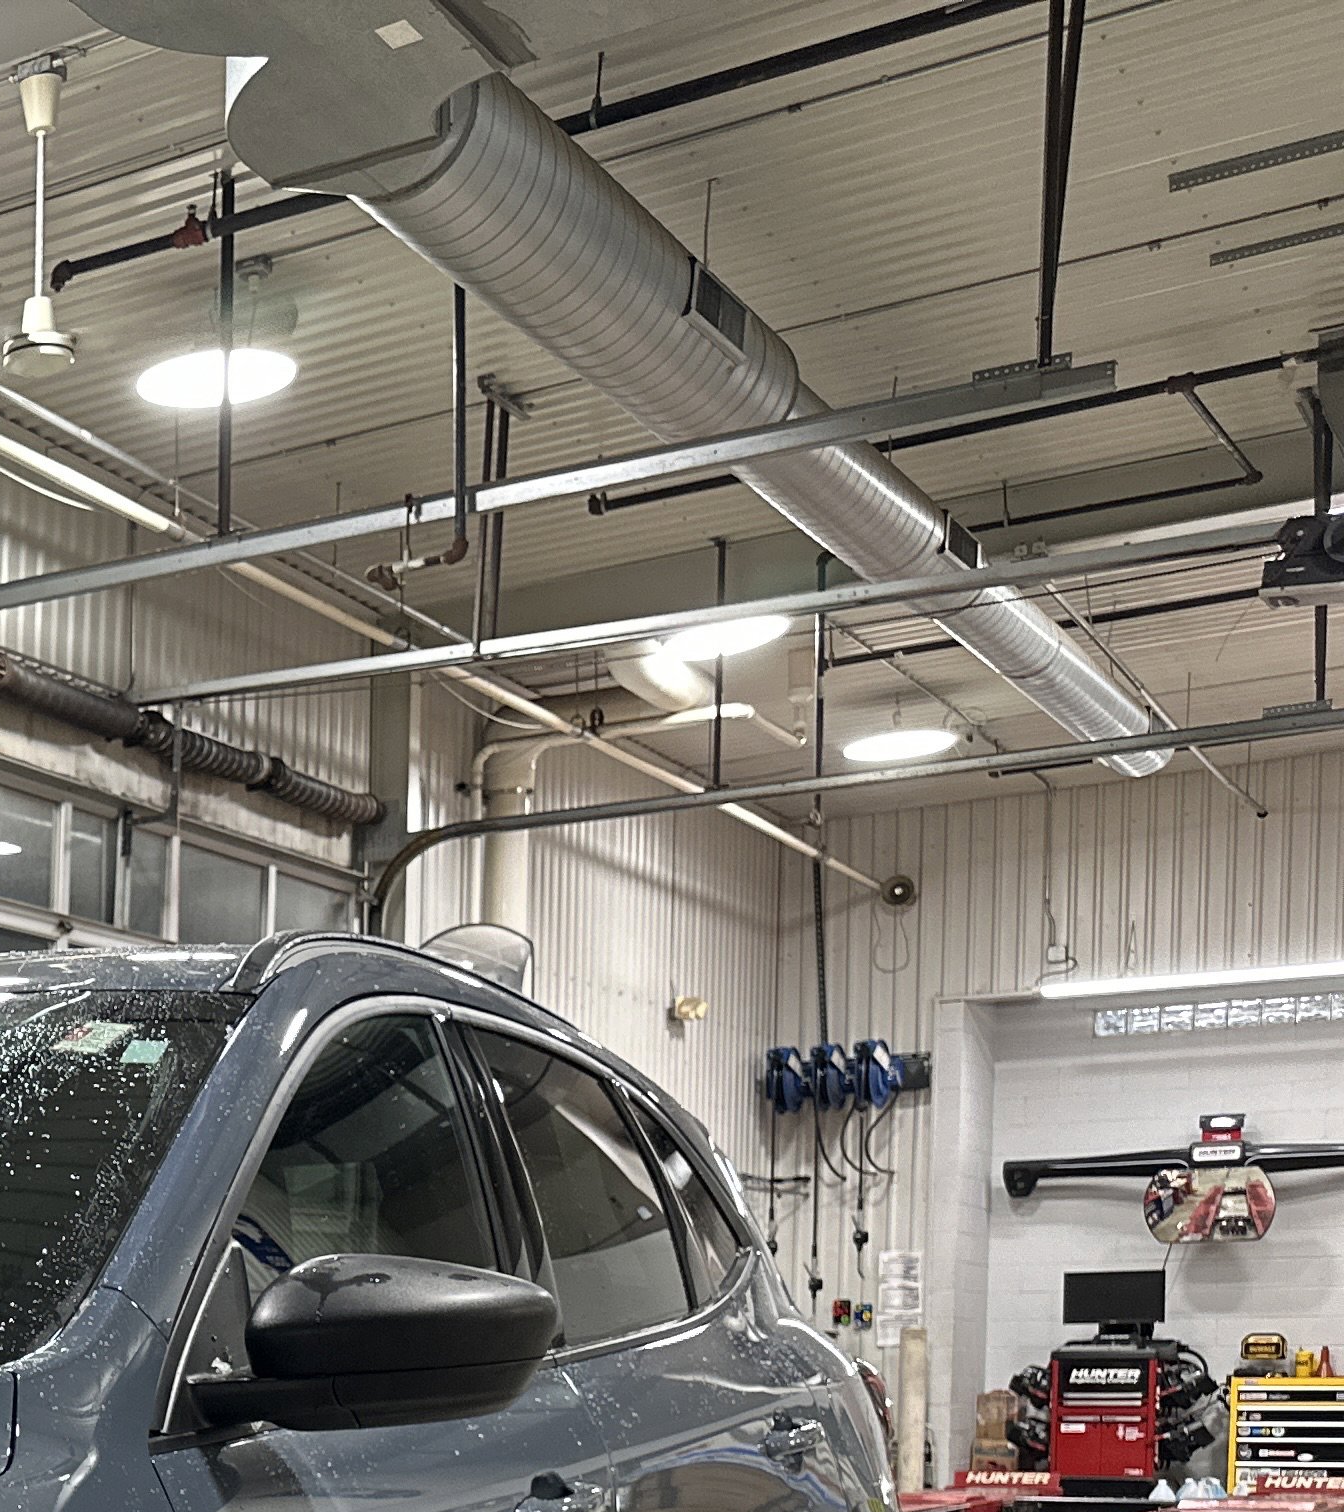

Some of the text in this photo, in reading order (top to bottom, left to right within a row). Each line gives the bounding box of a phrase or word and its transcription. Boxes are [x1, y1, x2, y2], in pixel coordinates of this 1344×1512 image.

[1069, 1368, 1141, 1381] HUNTER
[965, 1471, 1051, 1485] HUNTER
[1264, 1476, 1344, 1489] HUNTE
